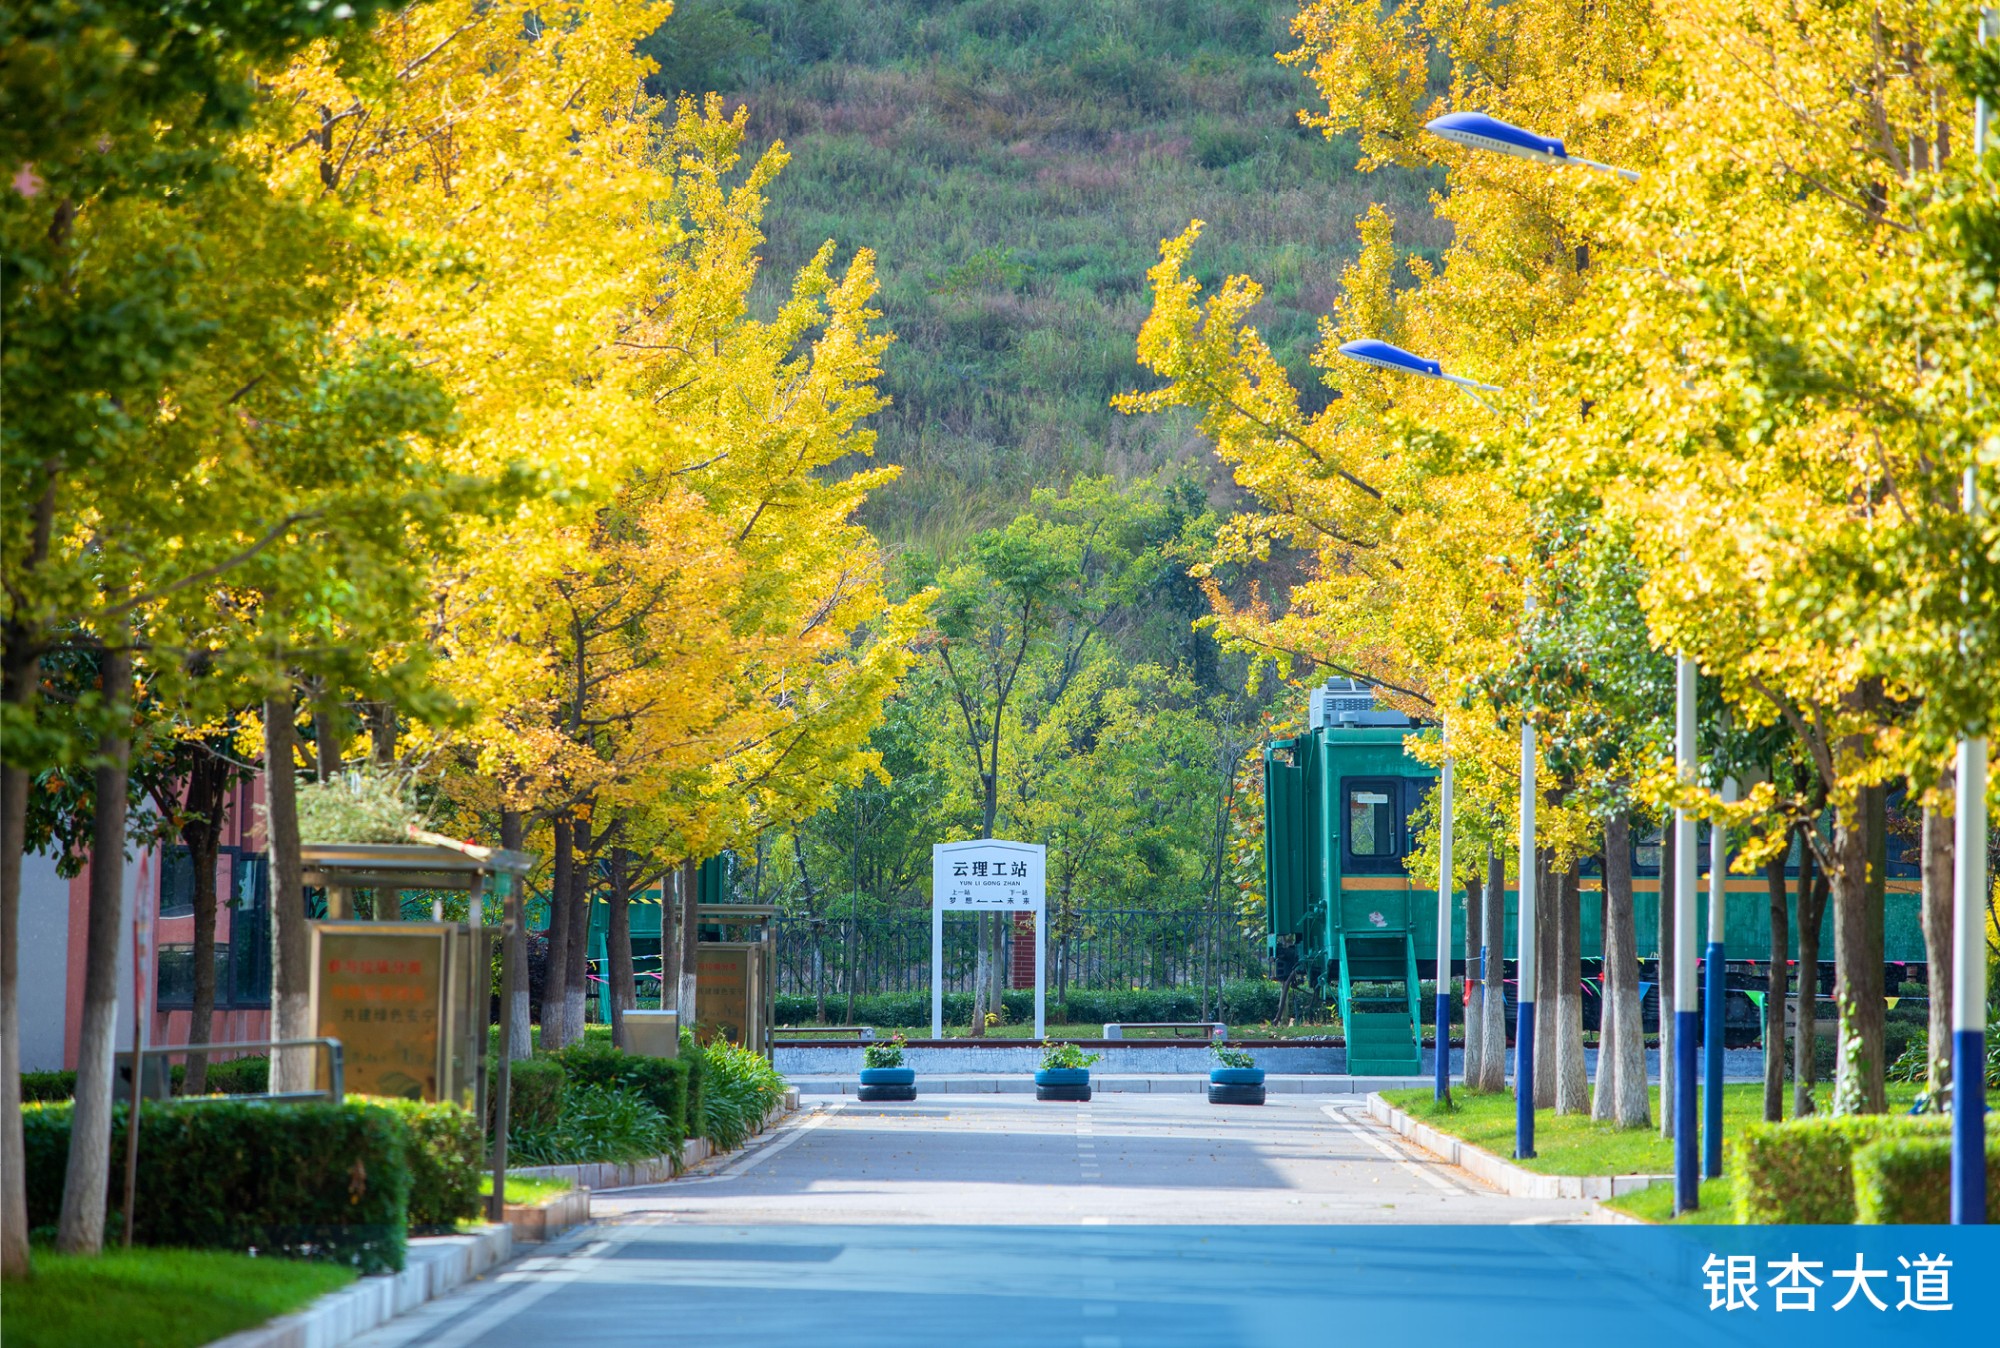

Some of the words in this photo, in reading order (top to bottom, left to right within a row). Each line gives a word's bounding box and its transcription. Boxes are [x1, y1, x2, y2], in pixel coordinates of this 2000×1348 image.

[952, 861, 1028, 877] 云理工站
[949, 897, 973, 905] 梦想
[1007, 897, 1030, 905] 未来
